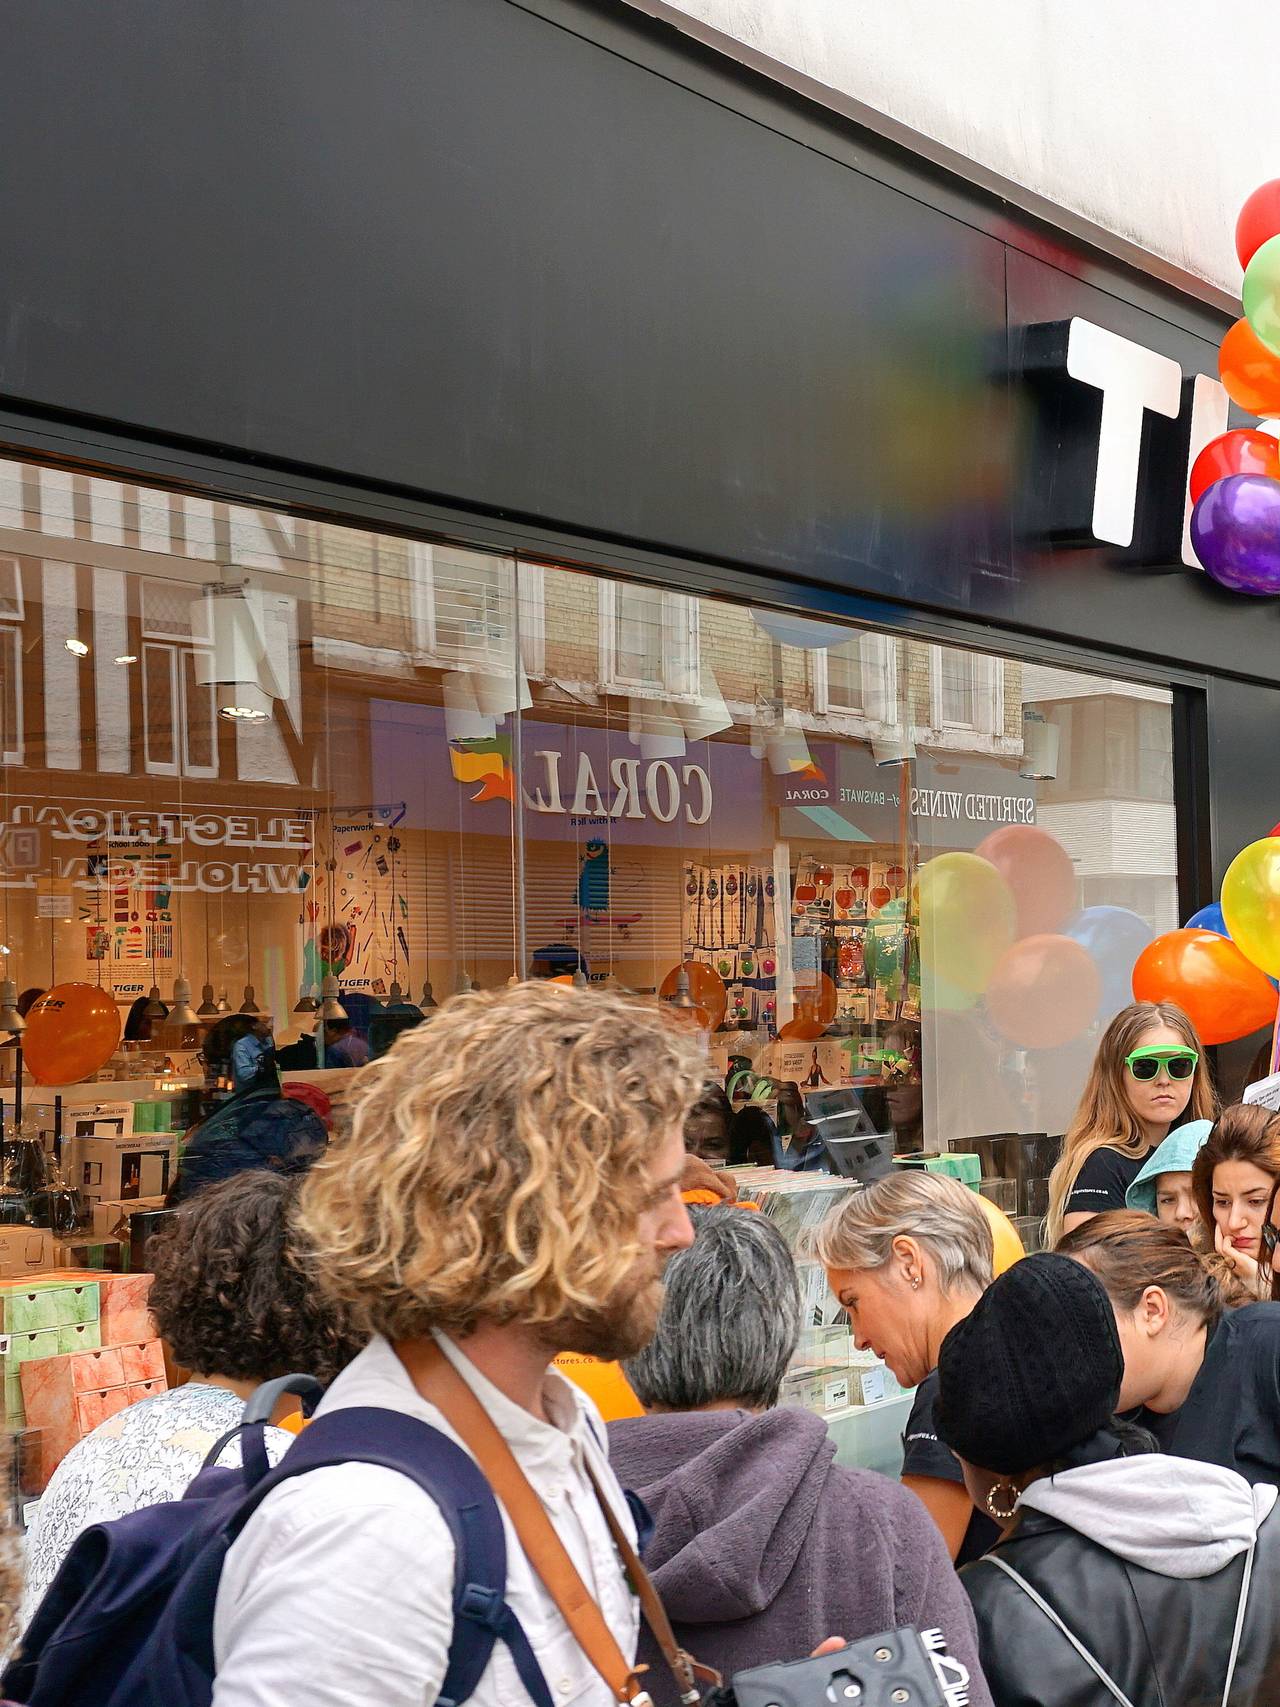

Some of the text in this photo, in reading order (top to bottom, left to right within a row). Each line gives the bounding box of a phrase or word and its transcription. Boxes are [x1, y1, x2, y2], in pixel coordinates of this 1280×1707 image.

[333, 822, 374, 834] Paperwork
[338, 979, 371, 987] TIGER
[113, 984, 145, 992] TIGER
